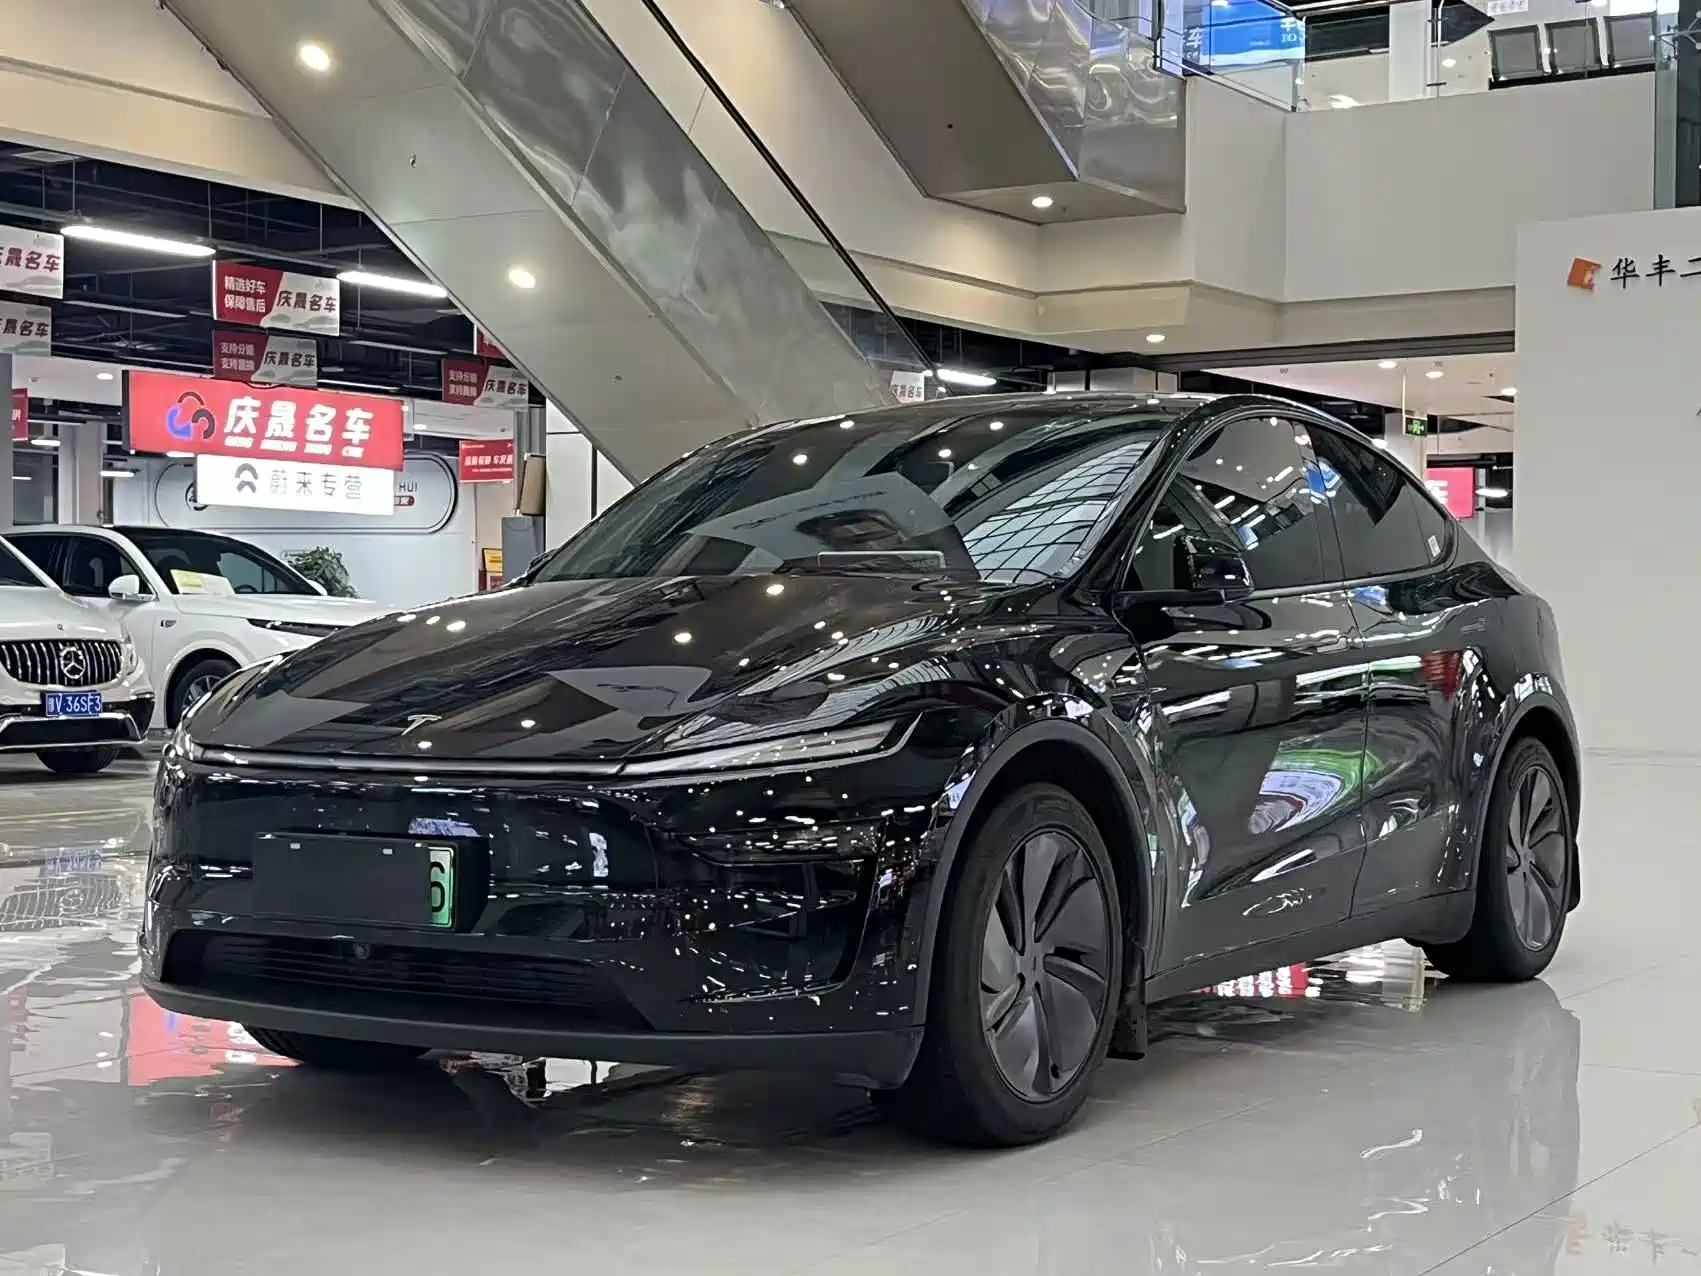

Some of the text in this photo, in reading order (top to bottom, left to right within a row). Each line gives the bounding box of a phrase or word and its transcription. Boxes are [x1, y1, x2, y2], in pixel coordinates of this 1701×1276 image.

[0, 246, 61, 272] 晟名车
[224, 275, 266, 295] 精选好车
[224, 293, 266, 313] 保障售后
[276, 290, 337, 313] 庆晟名车
[0, 318, 49, 337] 晟名车
[264, 351, 316, 368] 庆晟名车
[224, 396, 374, 445] 庆晟名车
[270, 468, 362, 500] 蔚来专营
